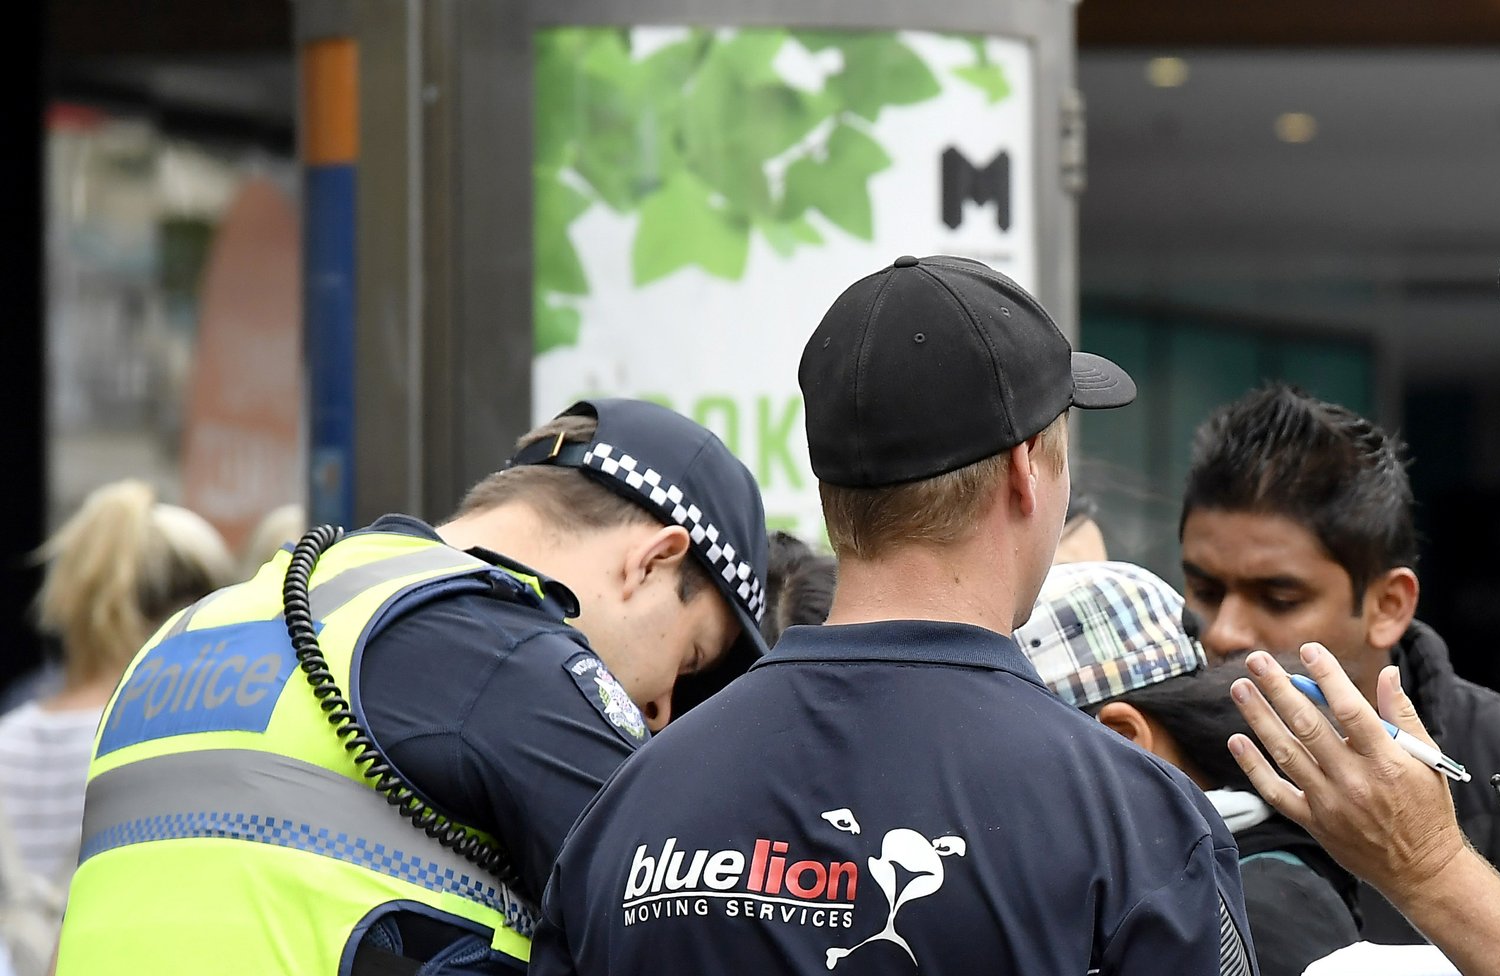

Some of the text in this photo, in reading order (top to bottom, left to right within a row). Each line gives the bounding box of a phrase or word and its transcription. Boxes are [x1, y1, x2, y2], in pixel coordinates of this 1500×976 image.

[111, 641, 282, 731] Police
[624, 898, 854, 929] MOVING SERVICES
